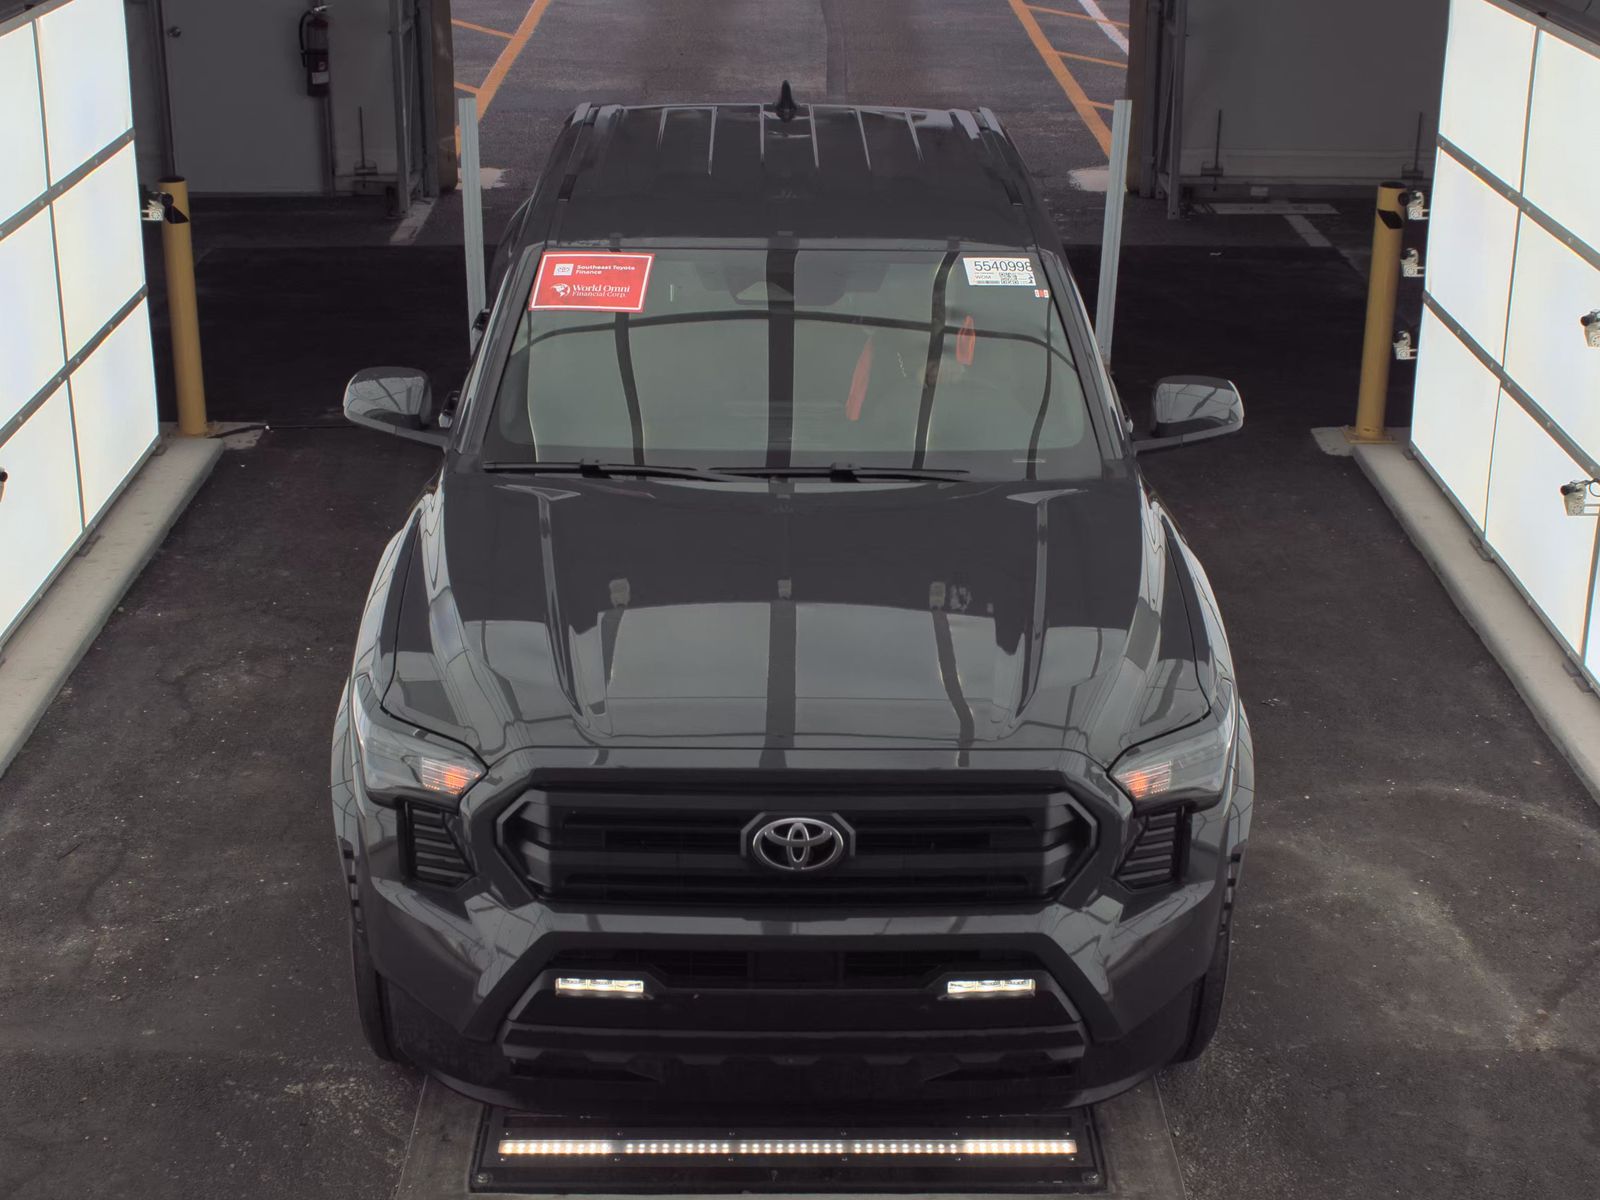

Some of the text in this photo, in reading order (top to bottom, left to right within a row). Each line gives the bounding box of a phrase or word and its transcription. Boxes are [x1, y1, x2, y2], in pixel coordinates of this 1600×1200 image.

[974, 261, 1033, 271] 5540998
[573, 284, 630, 293] World Omni
